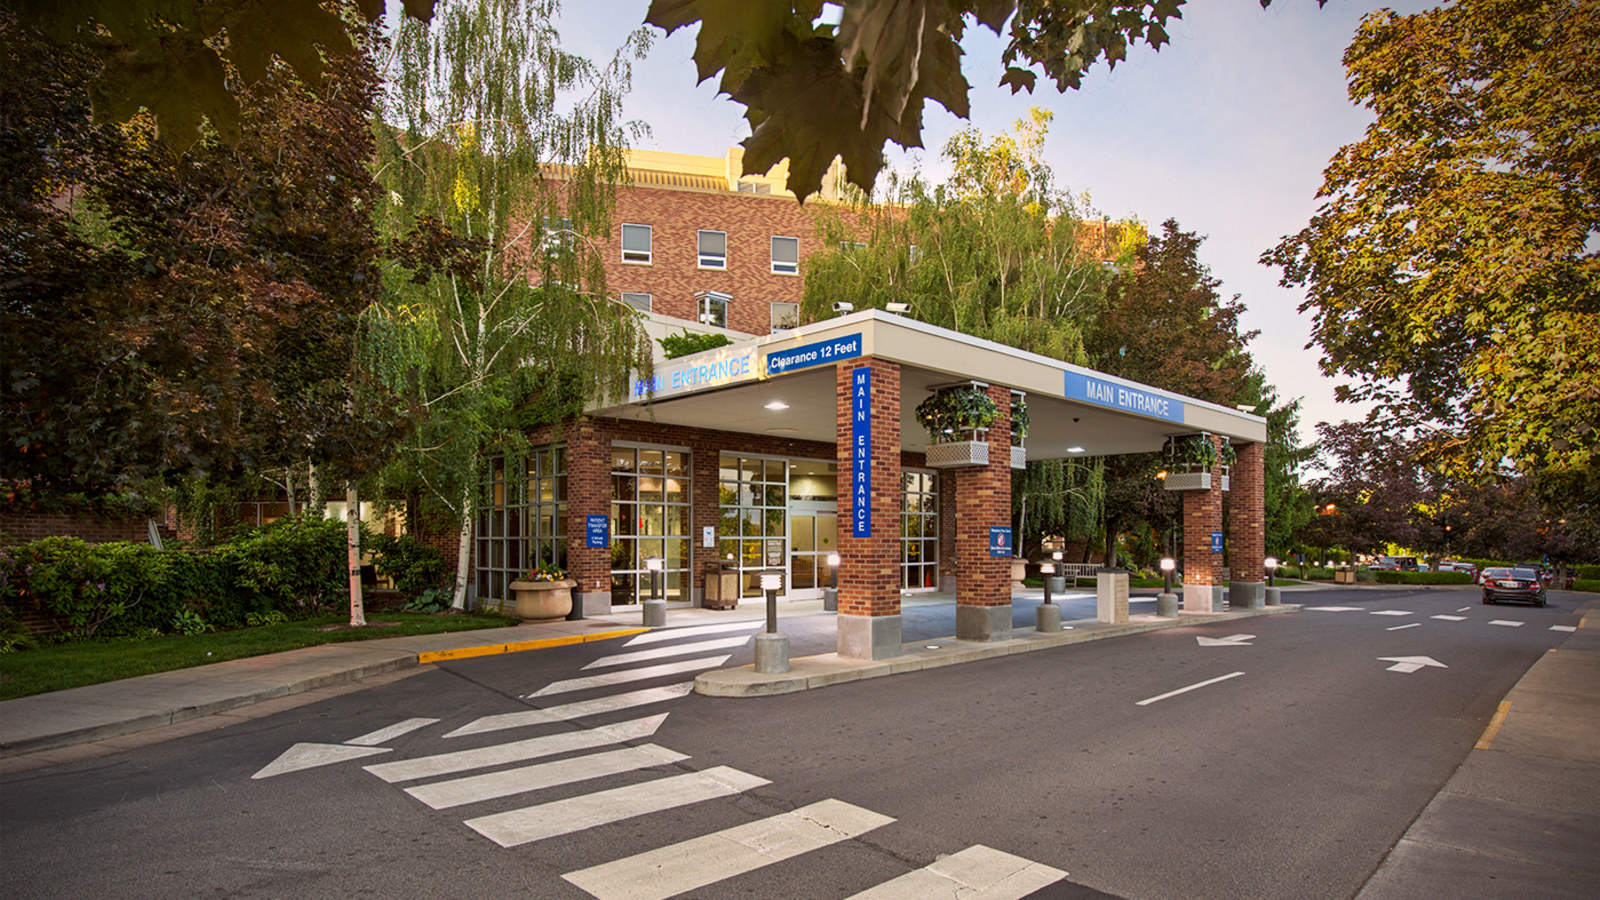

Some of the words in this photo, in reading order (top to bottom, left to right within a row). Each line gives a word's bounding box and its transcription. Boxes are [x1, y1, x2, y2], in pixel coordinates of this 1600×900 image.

[634, 374, 665, 397] MAIN
[672, 354, 750, 389] ENTRANCE
[771, 350, 818, 369] Clearance
[820, 346, 832, 358] 12
[834, 340, 858, 355] Feet
[857, 374, 866, 422] MAIN
[1086, 380, 1114, 403] MAIN
[1118, 388, 1169, 416] ENTRANCE
[857, 435, 866, 532] ENTRANCE
